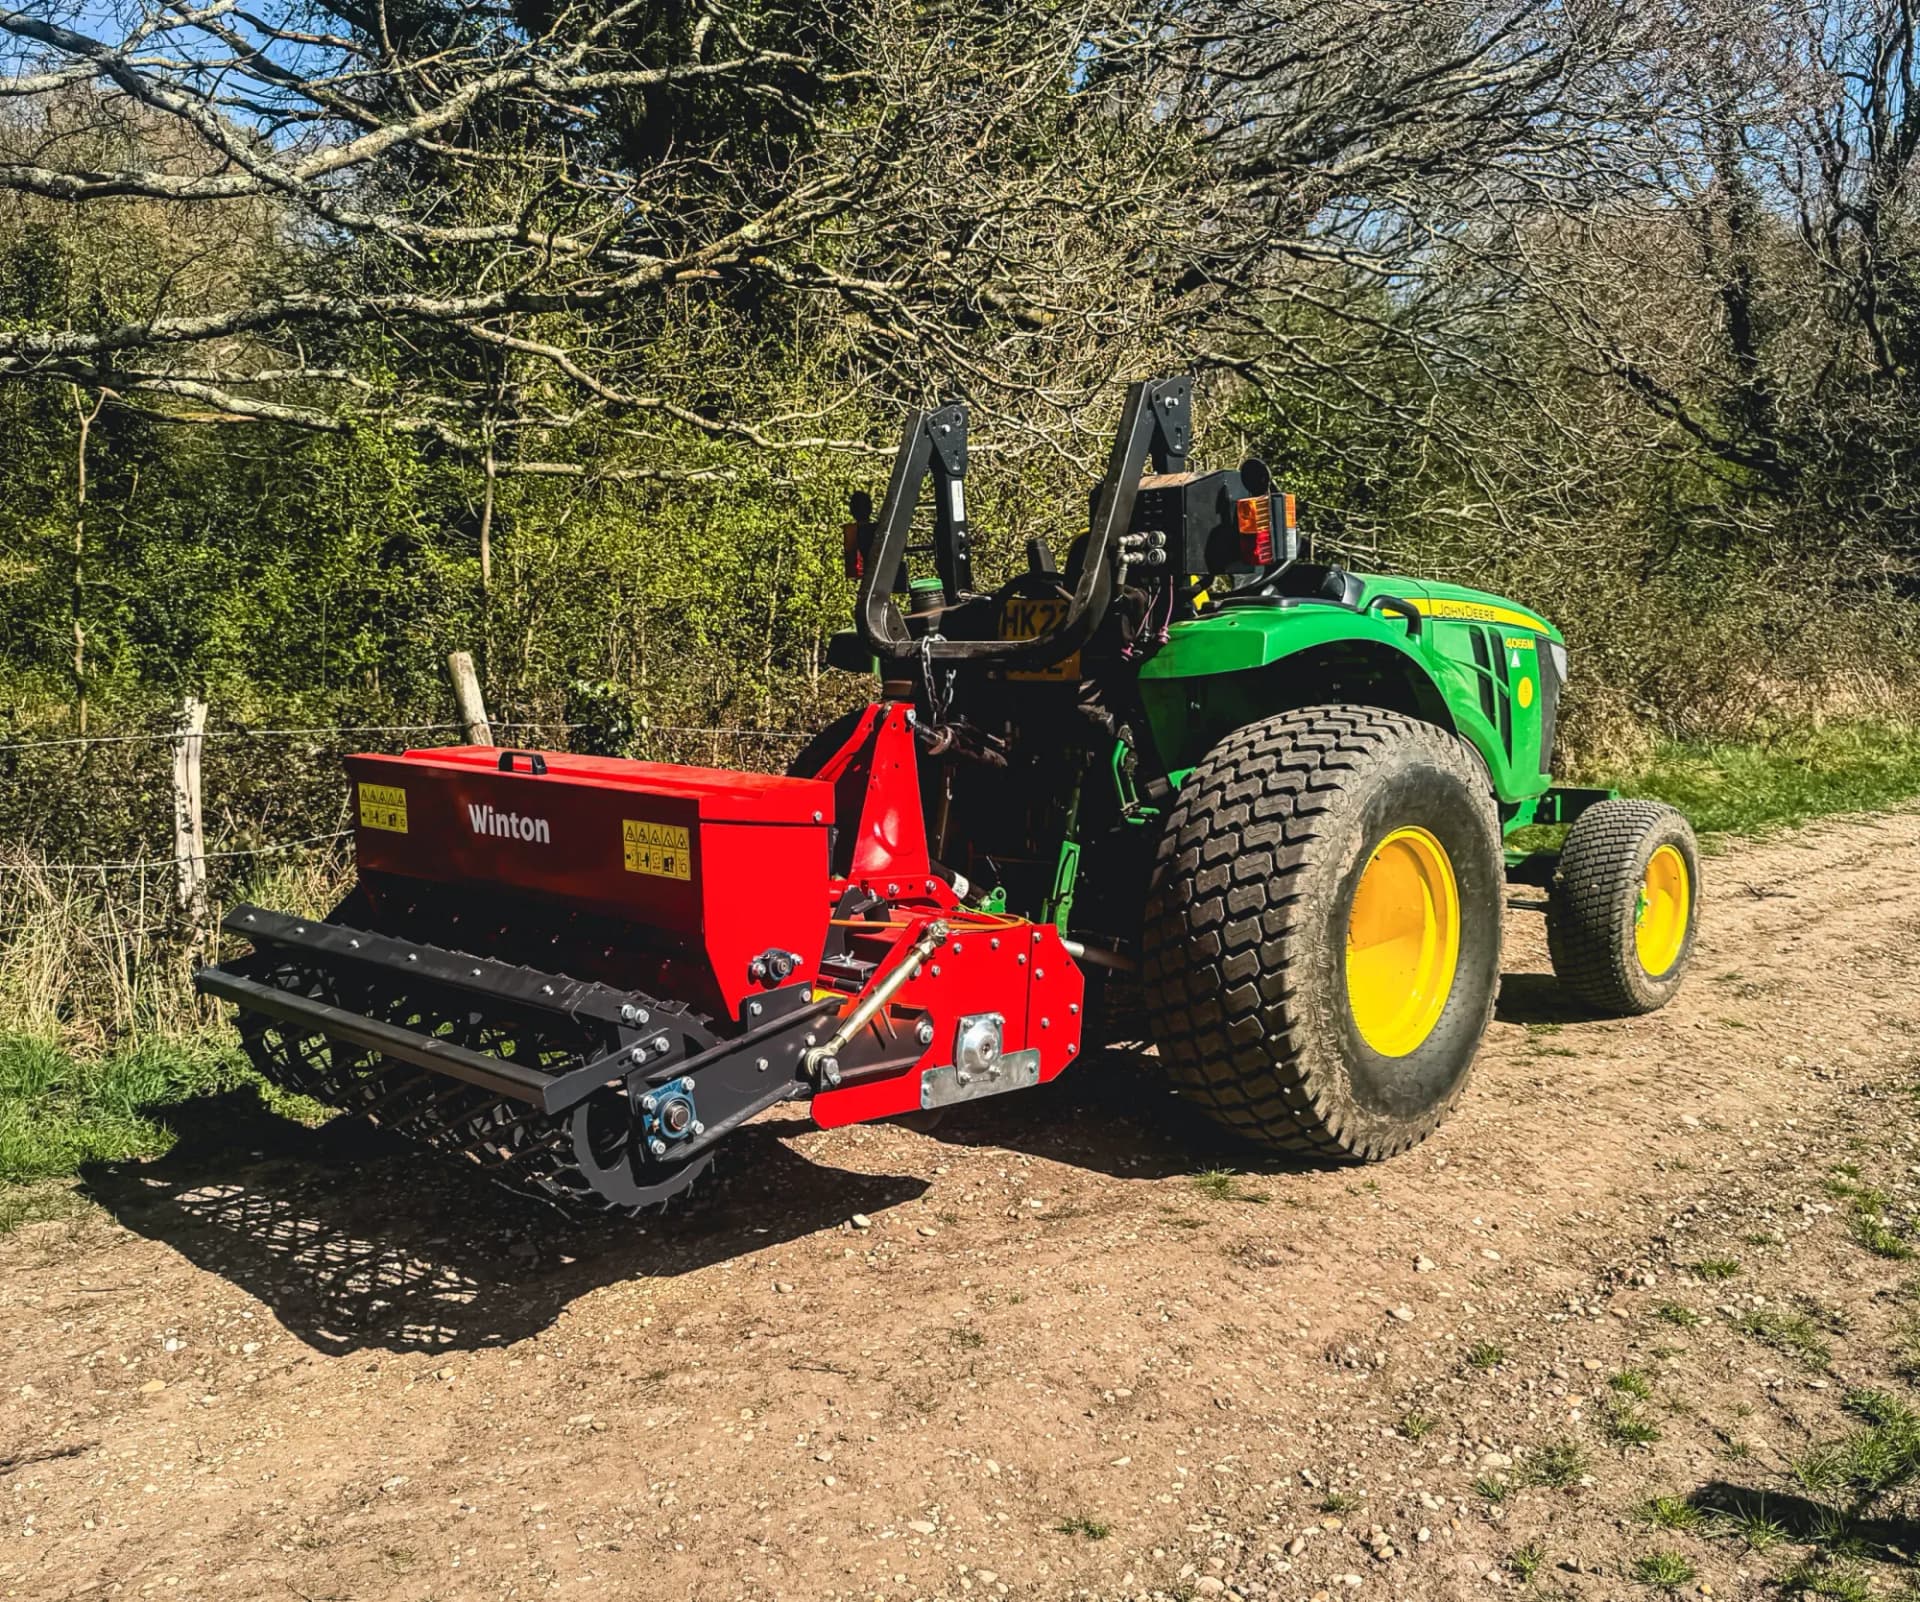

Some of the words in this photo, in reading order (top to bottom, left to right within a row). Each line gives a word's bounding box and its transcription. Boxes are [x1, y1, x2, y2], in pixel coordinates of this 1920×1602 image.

[1438, 603, 1465, 618] JOHN
[1465, 605, 1495, 621] DEERE
[467, 803, 551, 844] Winton
